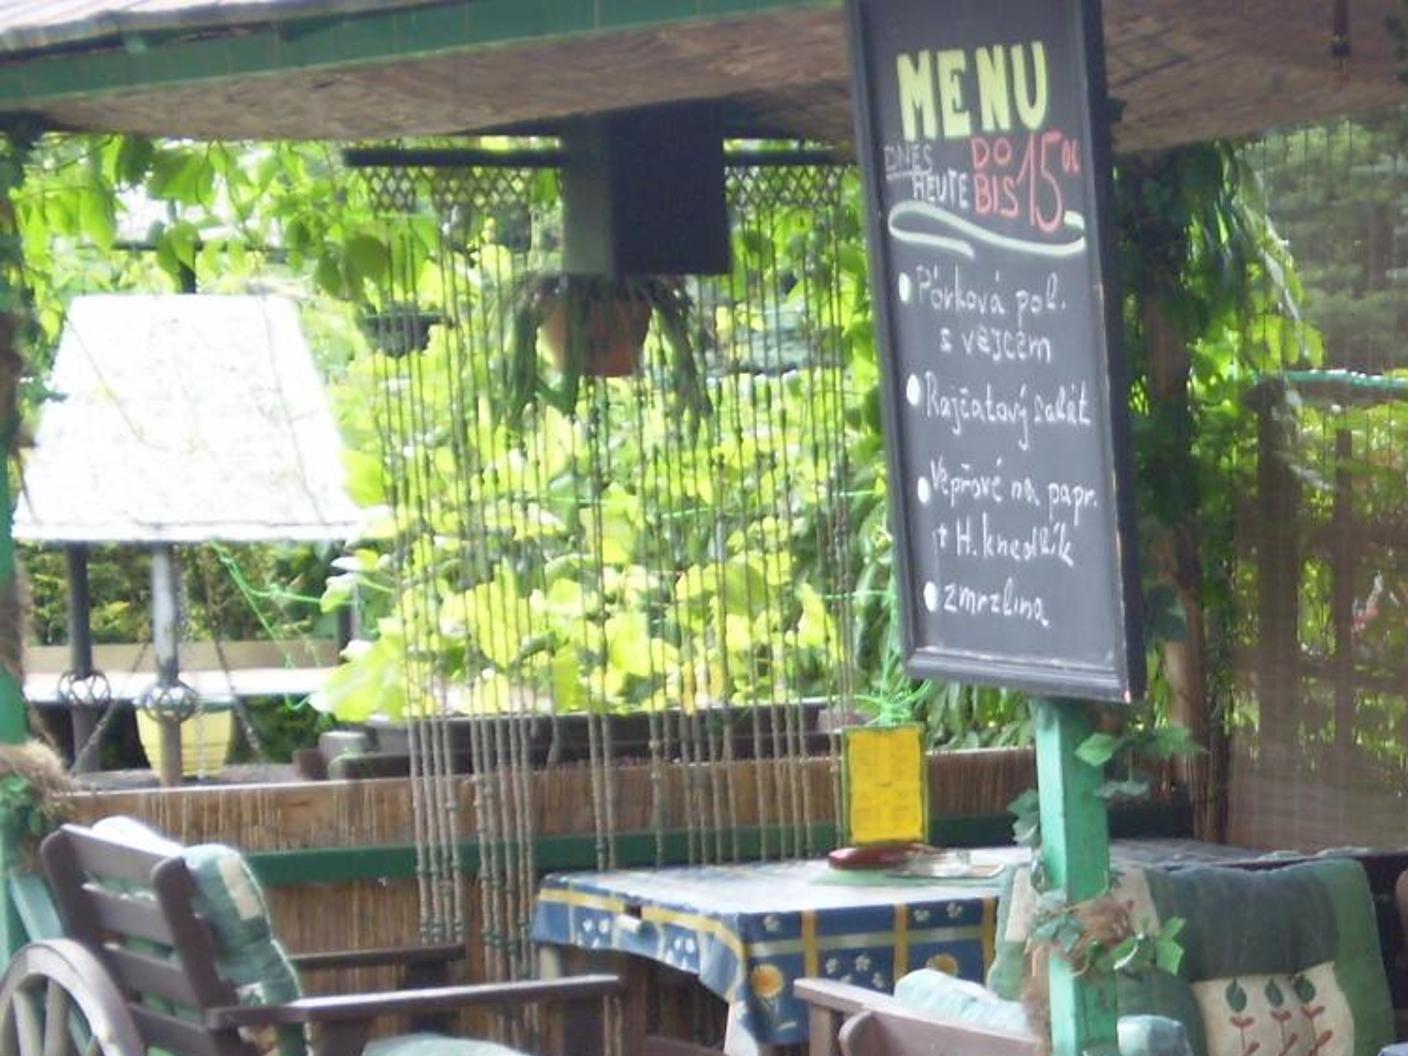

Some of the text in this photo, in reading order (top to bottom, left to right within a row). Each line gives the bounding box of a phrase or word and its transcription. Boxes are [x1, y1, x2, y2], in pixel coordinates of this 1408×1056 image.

[897, 40, 1048, 142] MENU
[971, 136, 1012, 169] DO
[911, 168, 969, 209] HEUTE
[973, 173, 1020, 218] BIS
[1010, 476, 1041, 506] na
